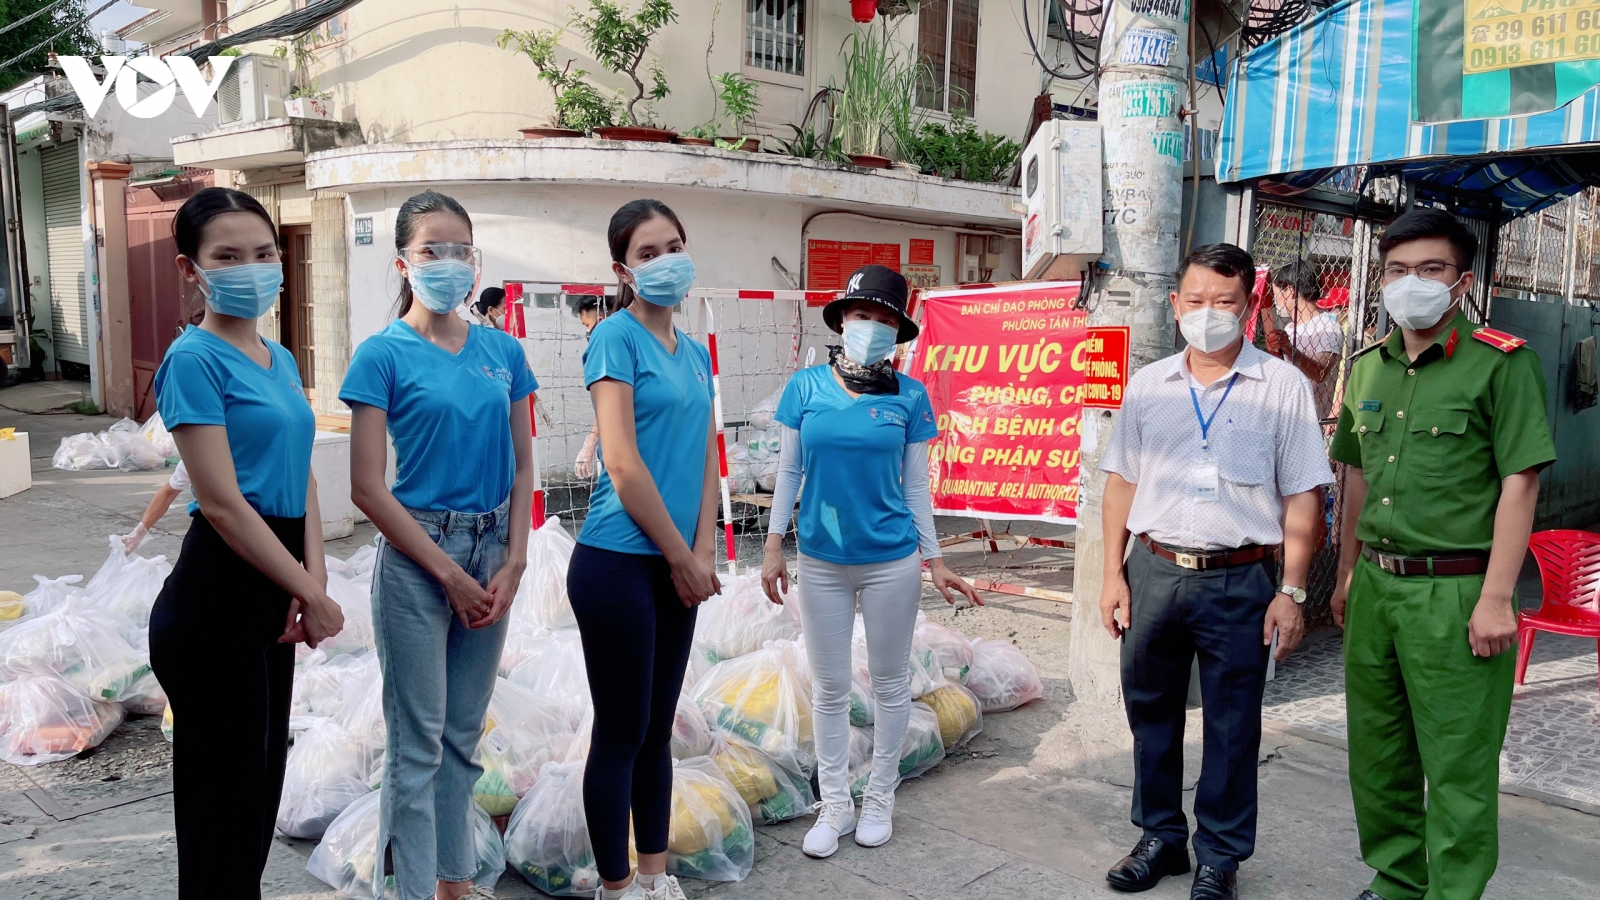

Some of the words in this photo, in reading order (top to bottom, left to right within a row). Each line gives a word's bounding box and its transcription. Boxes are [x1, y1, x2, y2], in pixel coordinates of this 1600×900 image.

[1495, 20, 1523, 42] 39
[1531, 13, 1567, 37] 611
[1470, 43, 1521, 68] 0913
[1529, 37, 1566, 60] 611
[961, 304, 980, 316] BAN
[983, 299, 1002, 314] CHỈ
[1003, 301, 1025, 314] ĐẠO
[1028, 297, 1065, 311] PHÒNG
[1002, 317, 1046, 332] PHƯỜNG
[1049, 315, 1069, 330] TÂN
[923, 344, 989, 373] KHU
[999, 337, 1062, 381] VỰC
[1091, 357, 1120, 380] PHÒNG,
[969, 382, 1053, 408] PHÒNG,
[993, 414, 1056, 440] BỆNH
[981, 445, 1041, 471] PHẬN
[941, 479, 998, 497] QUARANTINE
[999, 482, 1024, 498] AREA
